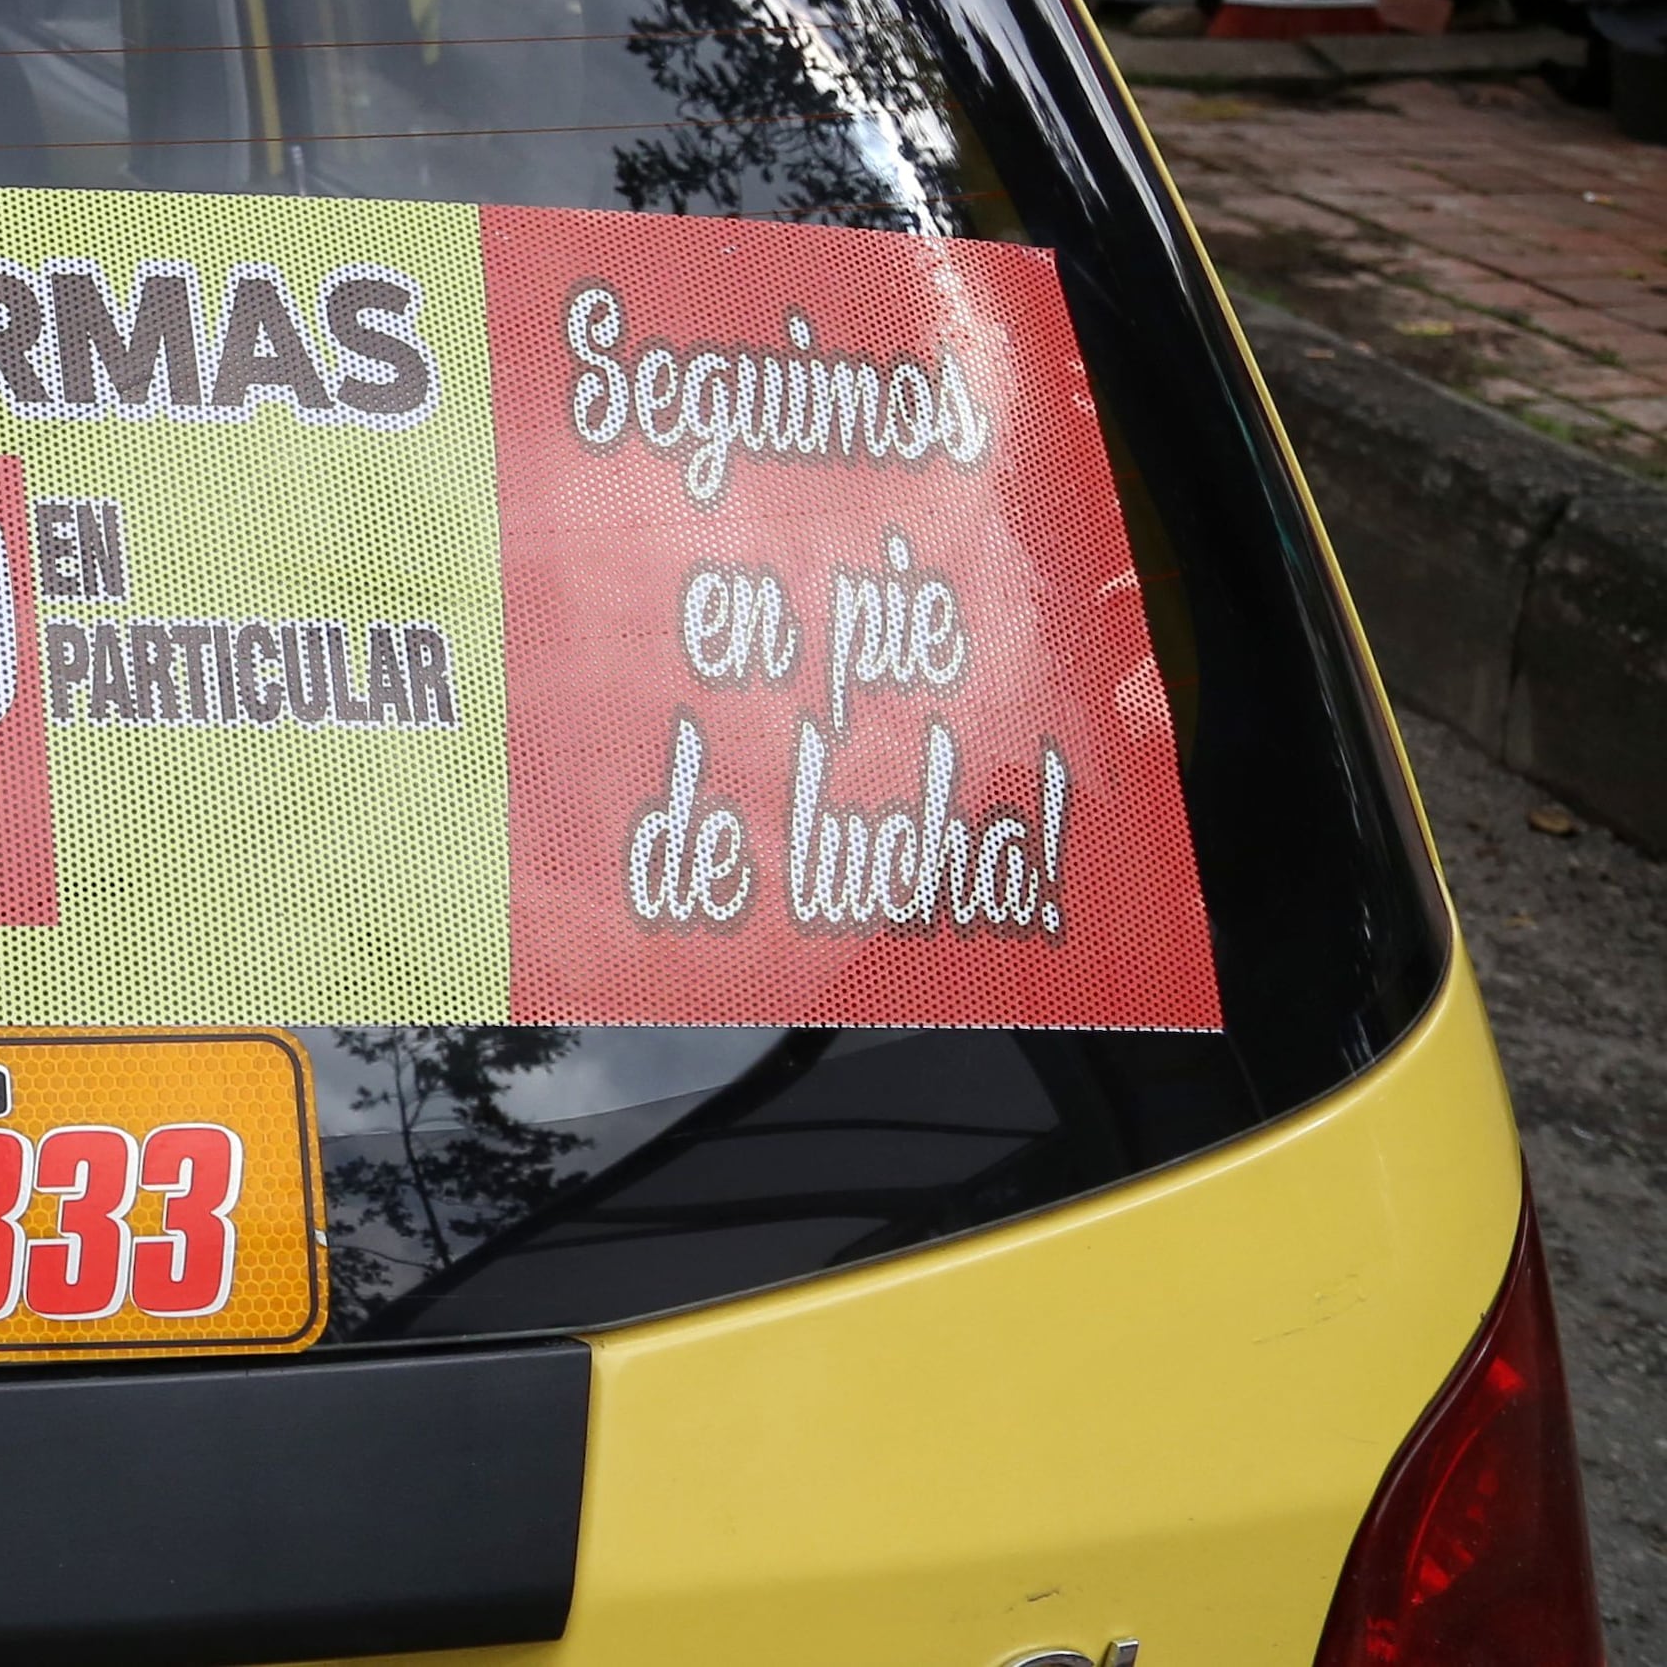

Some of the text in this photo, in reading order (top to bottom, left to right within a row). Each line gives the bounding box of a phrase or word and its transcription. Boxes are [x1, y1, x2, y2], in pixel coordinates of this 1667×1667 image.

[567, 287, 990, 501] Seguimos
[39, 500, 122, 601] EN
[683, 533, 965, 734] en pie
[50, 621, 457, 726] PARTICULAR
[628, 720, 1069, 934] de lucha!
